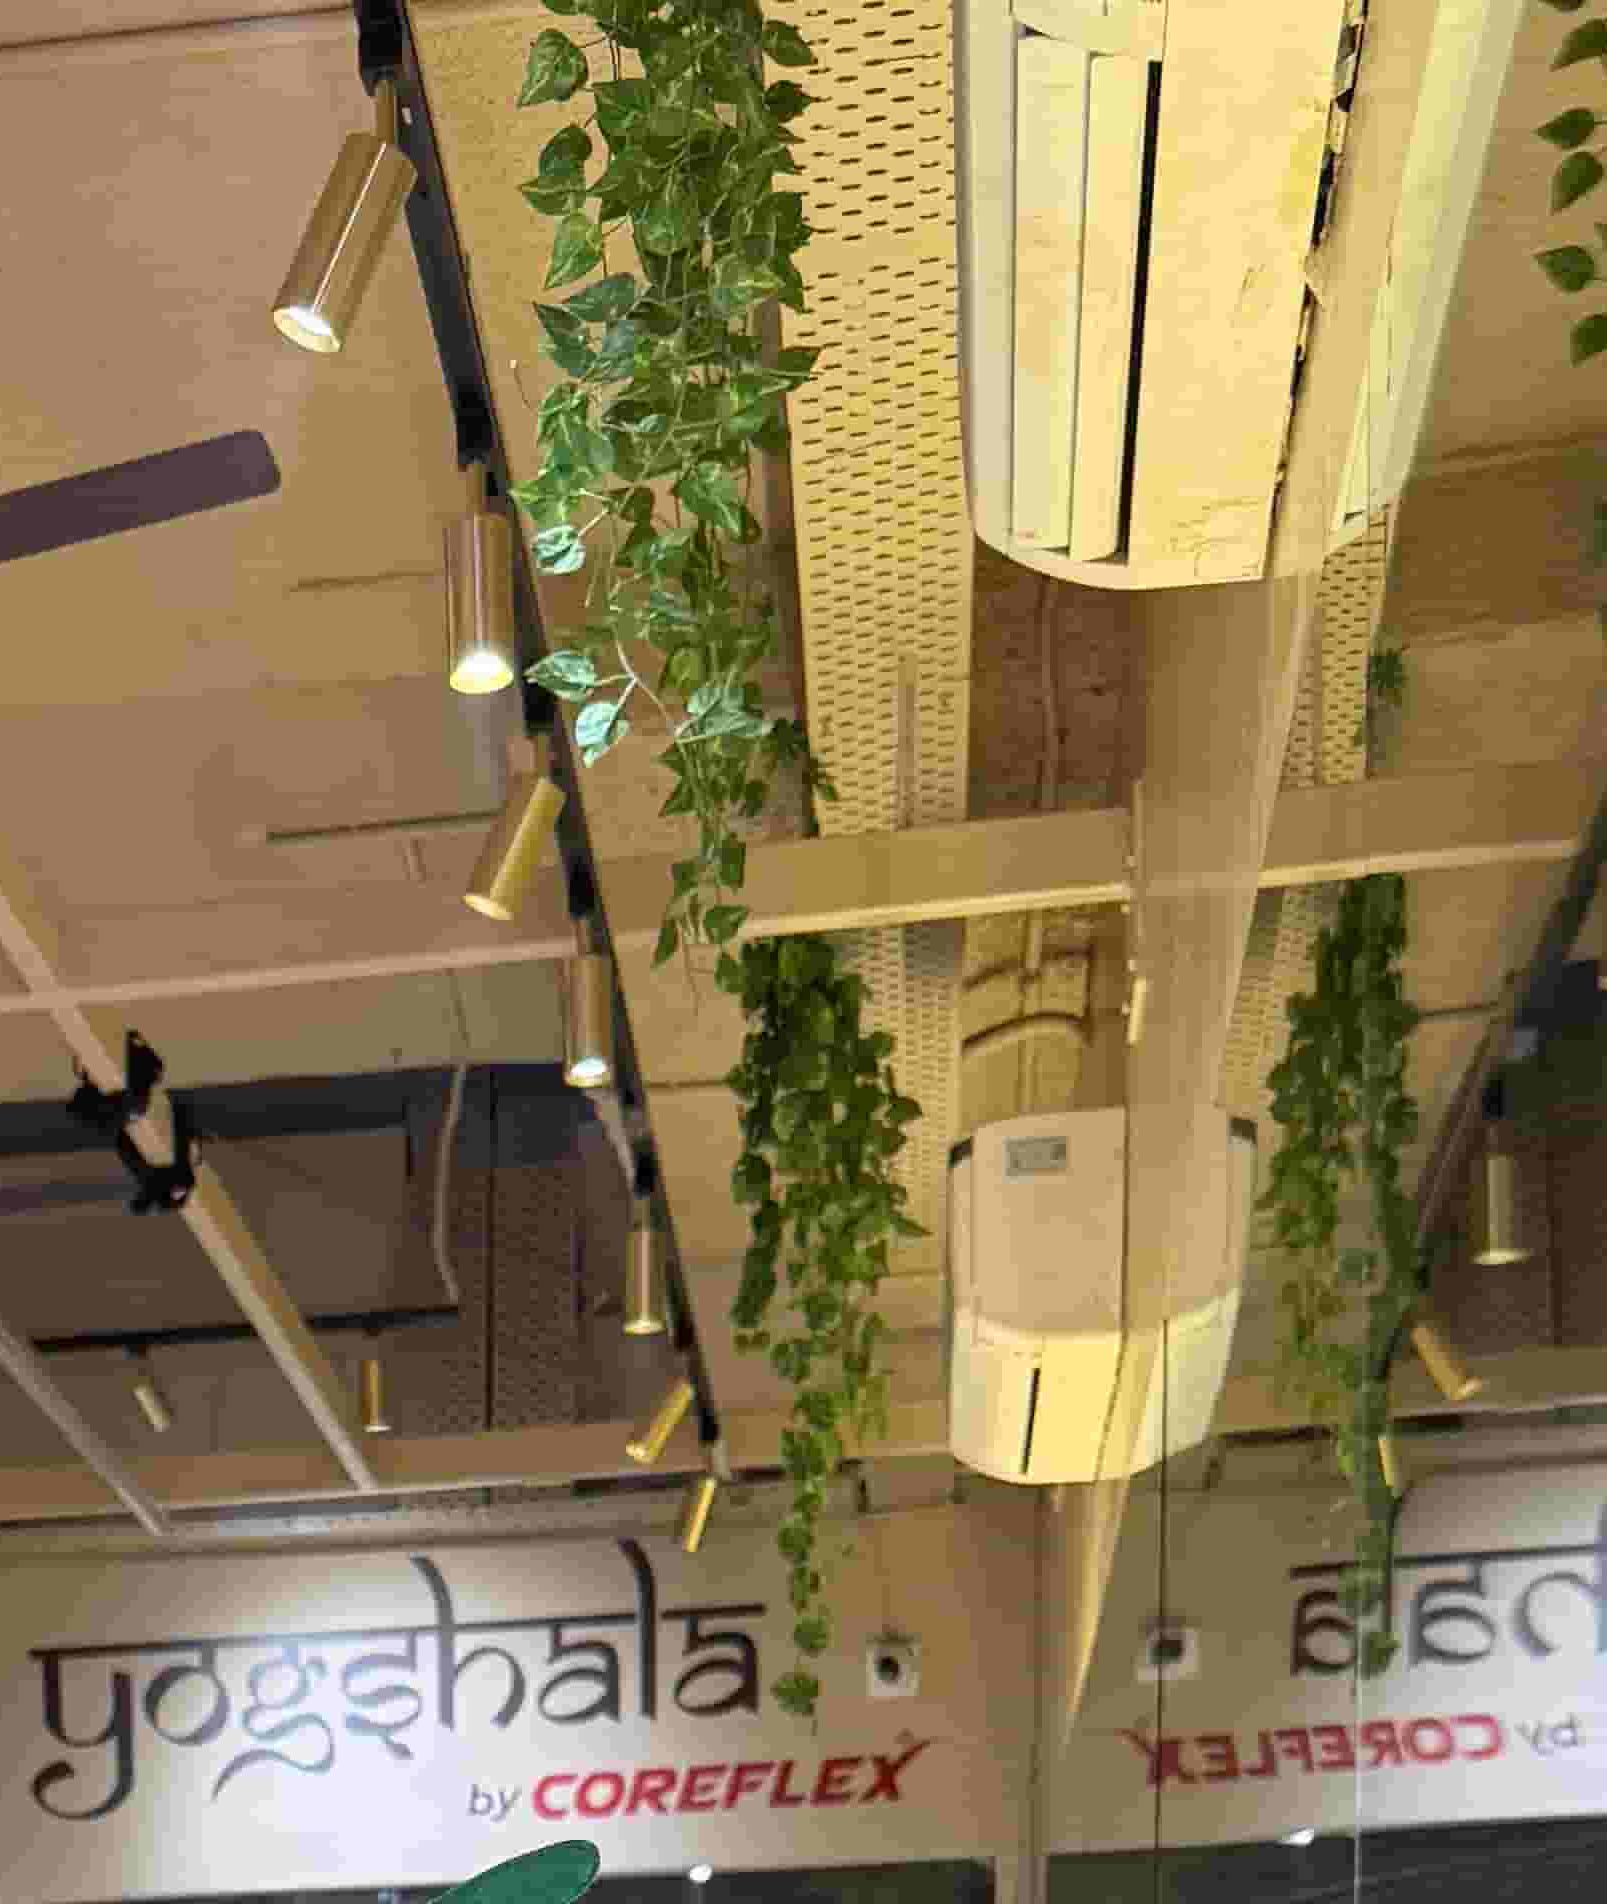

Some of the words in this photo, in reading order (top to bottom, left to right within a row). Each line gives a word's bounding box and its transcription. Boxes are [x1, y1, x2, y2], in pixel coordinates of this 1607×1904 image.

[27, 1537, 767, 1820] yogshala
[467, 1784, 520, 1821] by
[530, 1738, 930, 1820] COREFLEX
